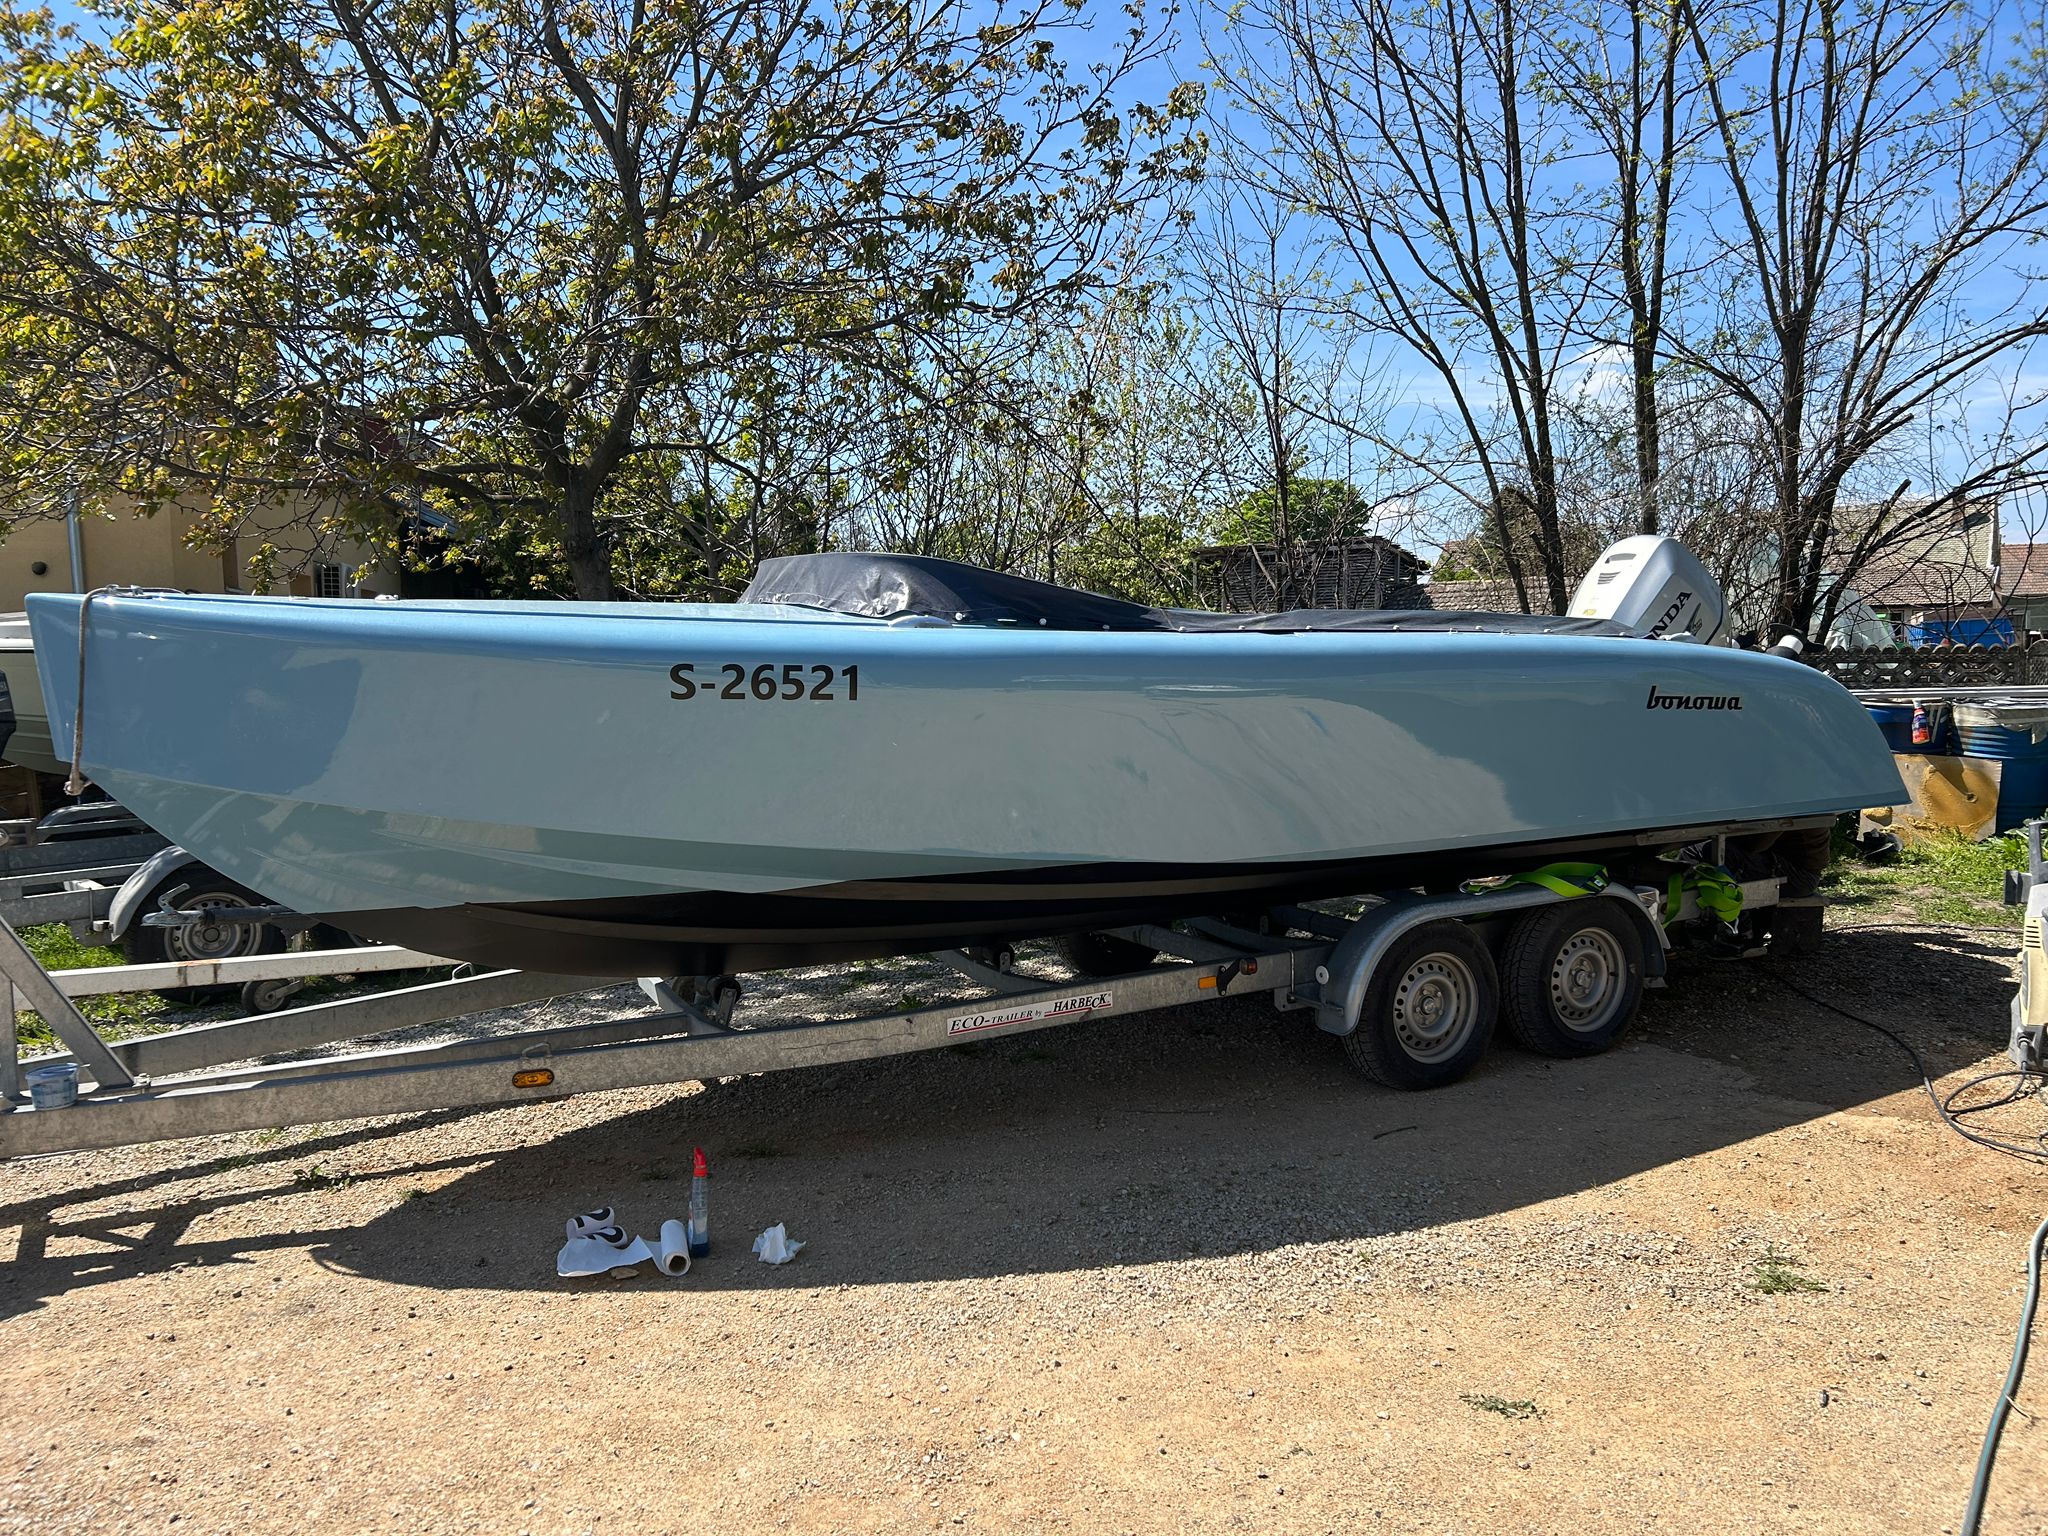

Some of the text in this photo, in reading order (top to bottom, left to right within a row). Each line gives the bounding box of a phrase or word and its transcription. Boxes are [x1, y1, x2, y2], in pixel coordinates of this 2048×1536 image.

[669, 663, 858, 701] S-26521
[1646, 685, 1743, 710] bonowa
[951, 1010, 1033, 1031] ECO-TRAILER
[1053, 993, 1108, 1012] HARBECK
